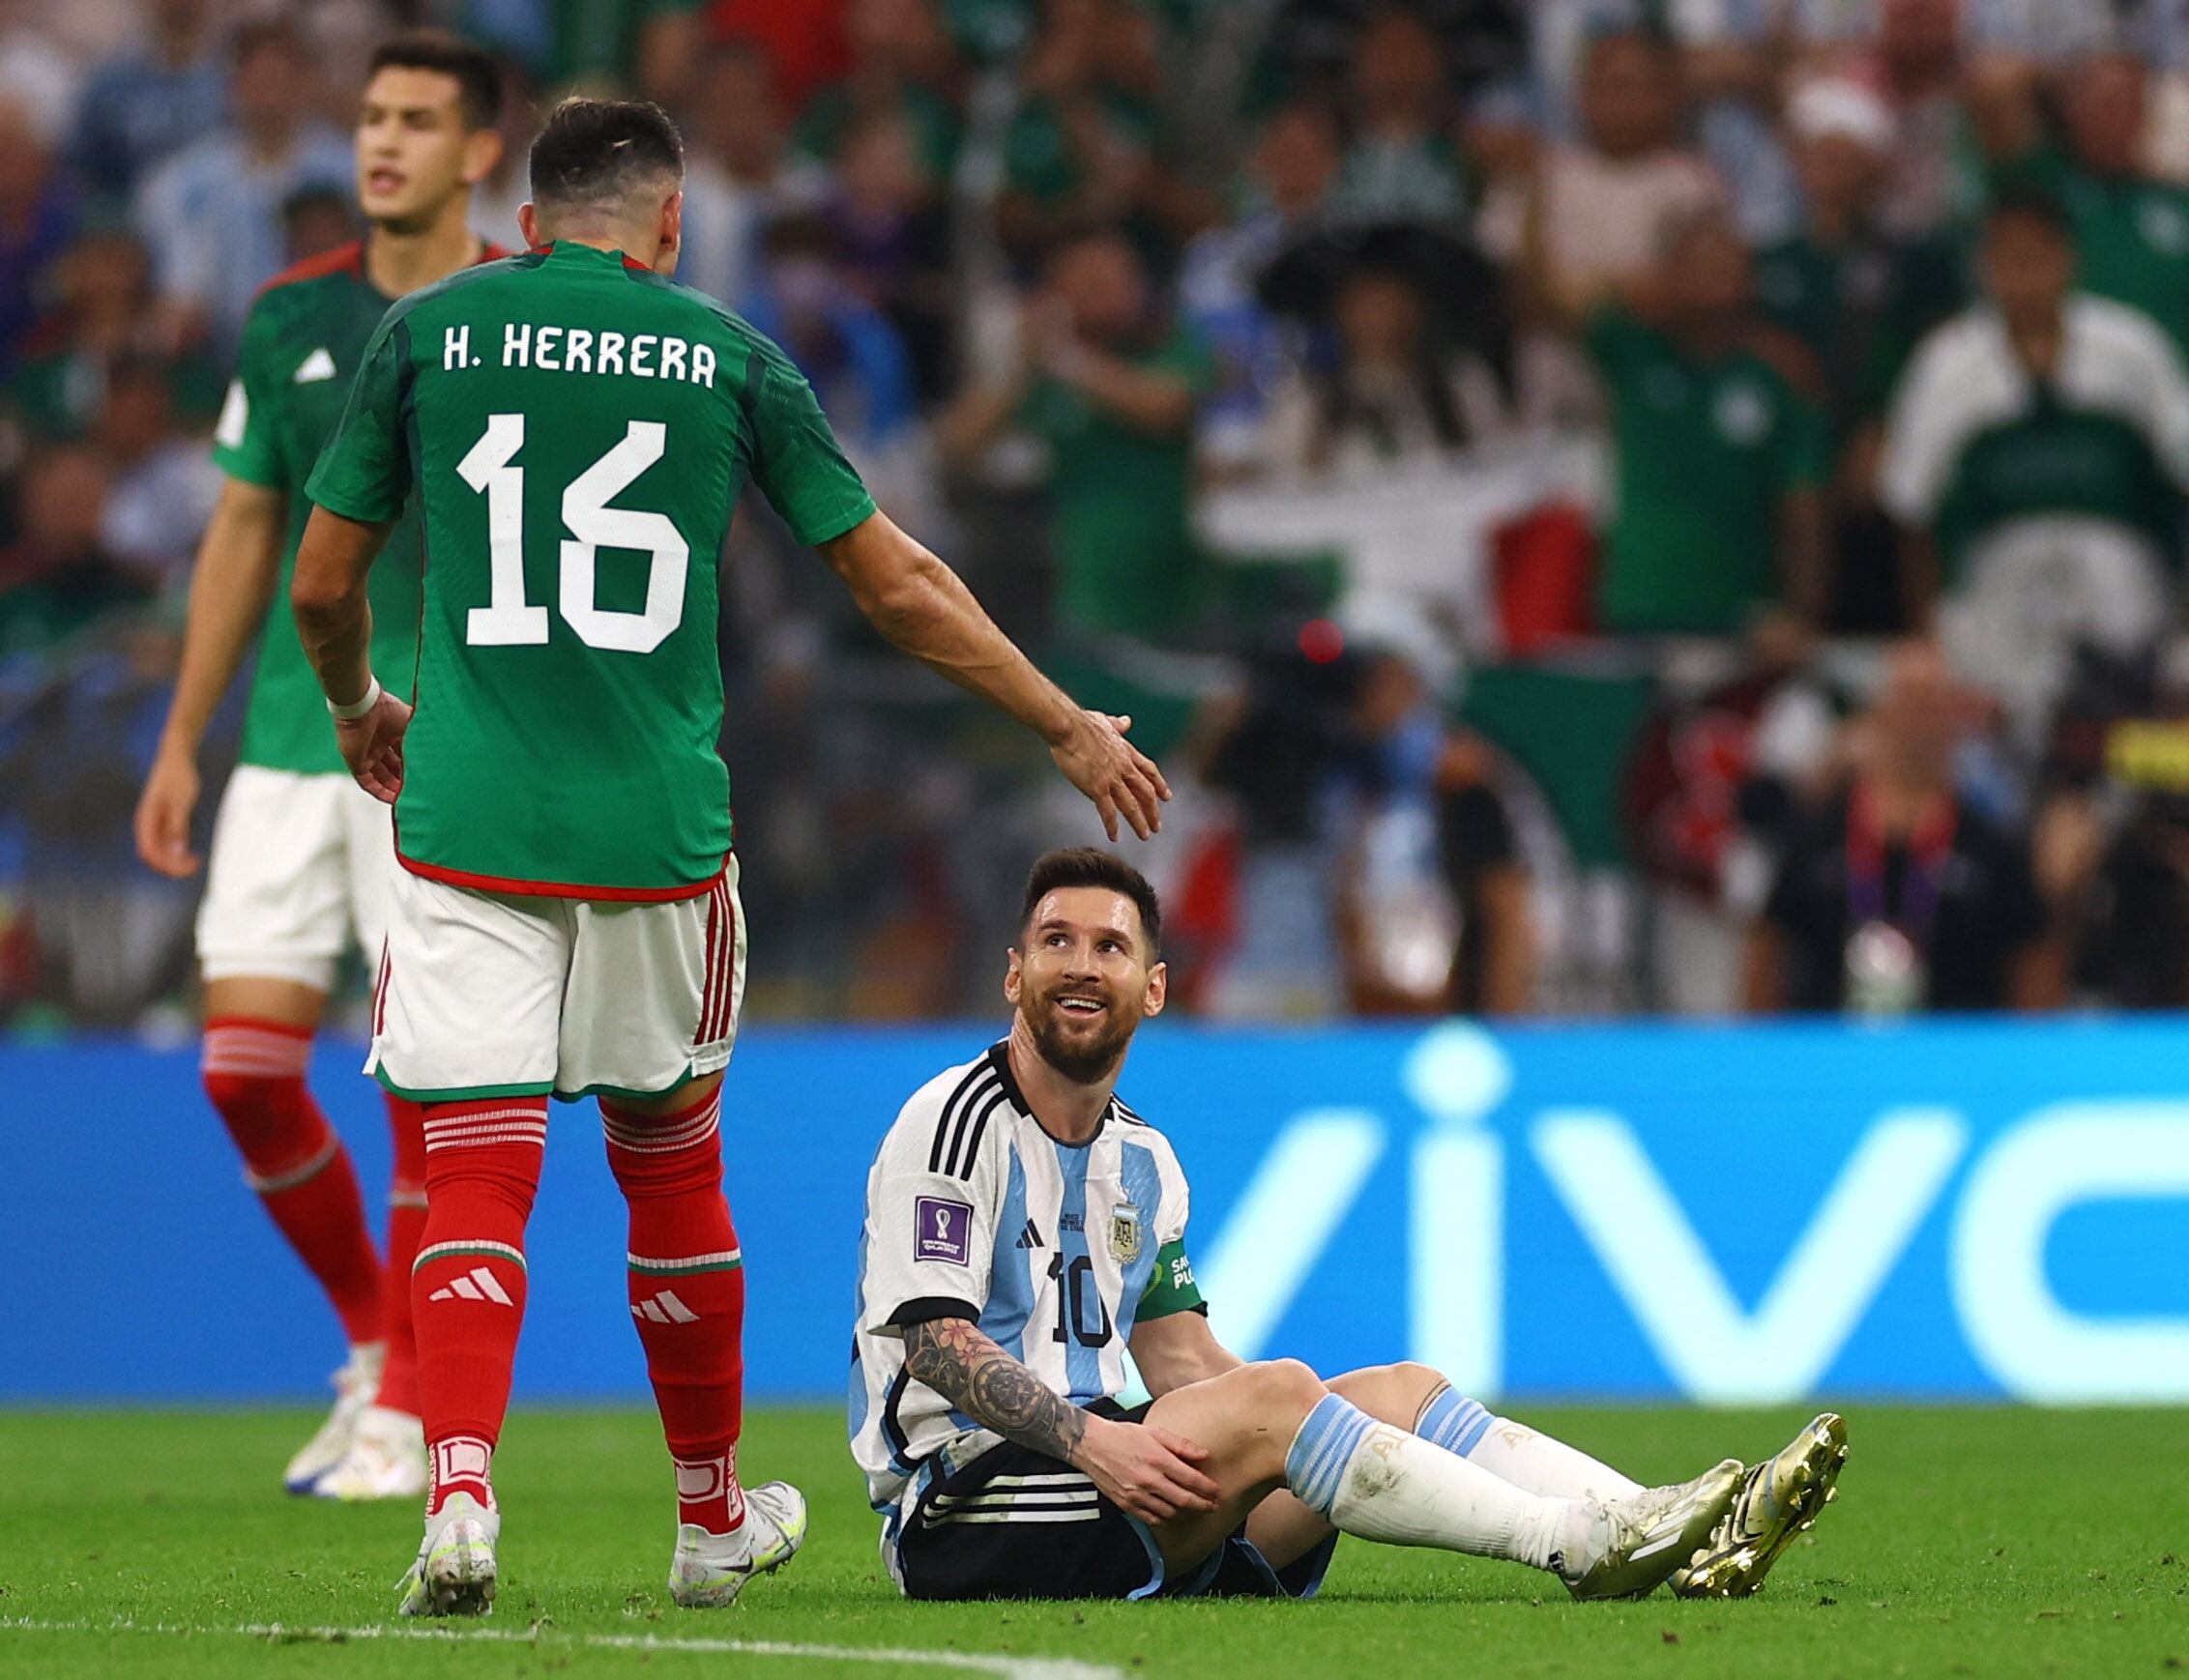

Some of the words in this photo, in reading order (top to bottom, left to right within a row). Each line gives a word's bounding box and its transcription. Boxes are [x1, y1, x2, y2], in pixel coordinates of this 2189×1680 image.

[444, 325, 482, 371] H.
[502, 323, 716, 389] HERRERA
[455, 414, 689, 653] 16
[1047, 1251, 1112, 1348] 10
